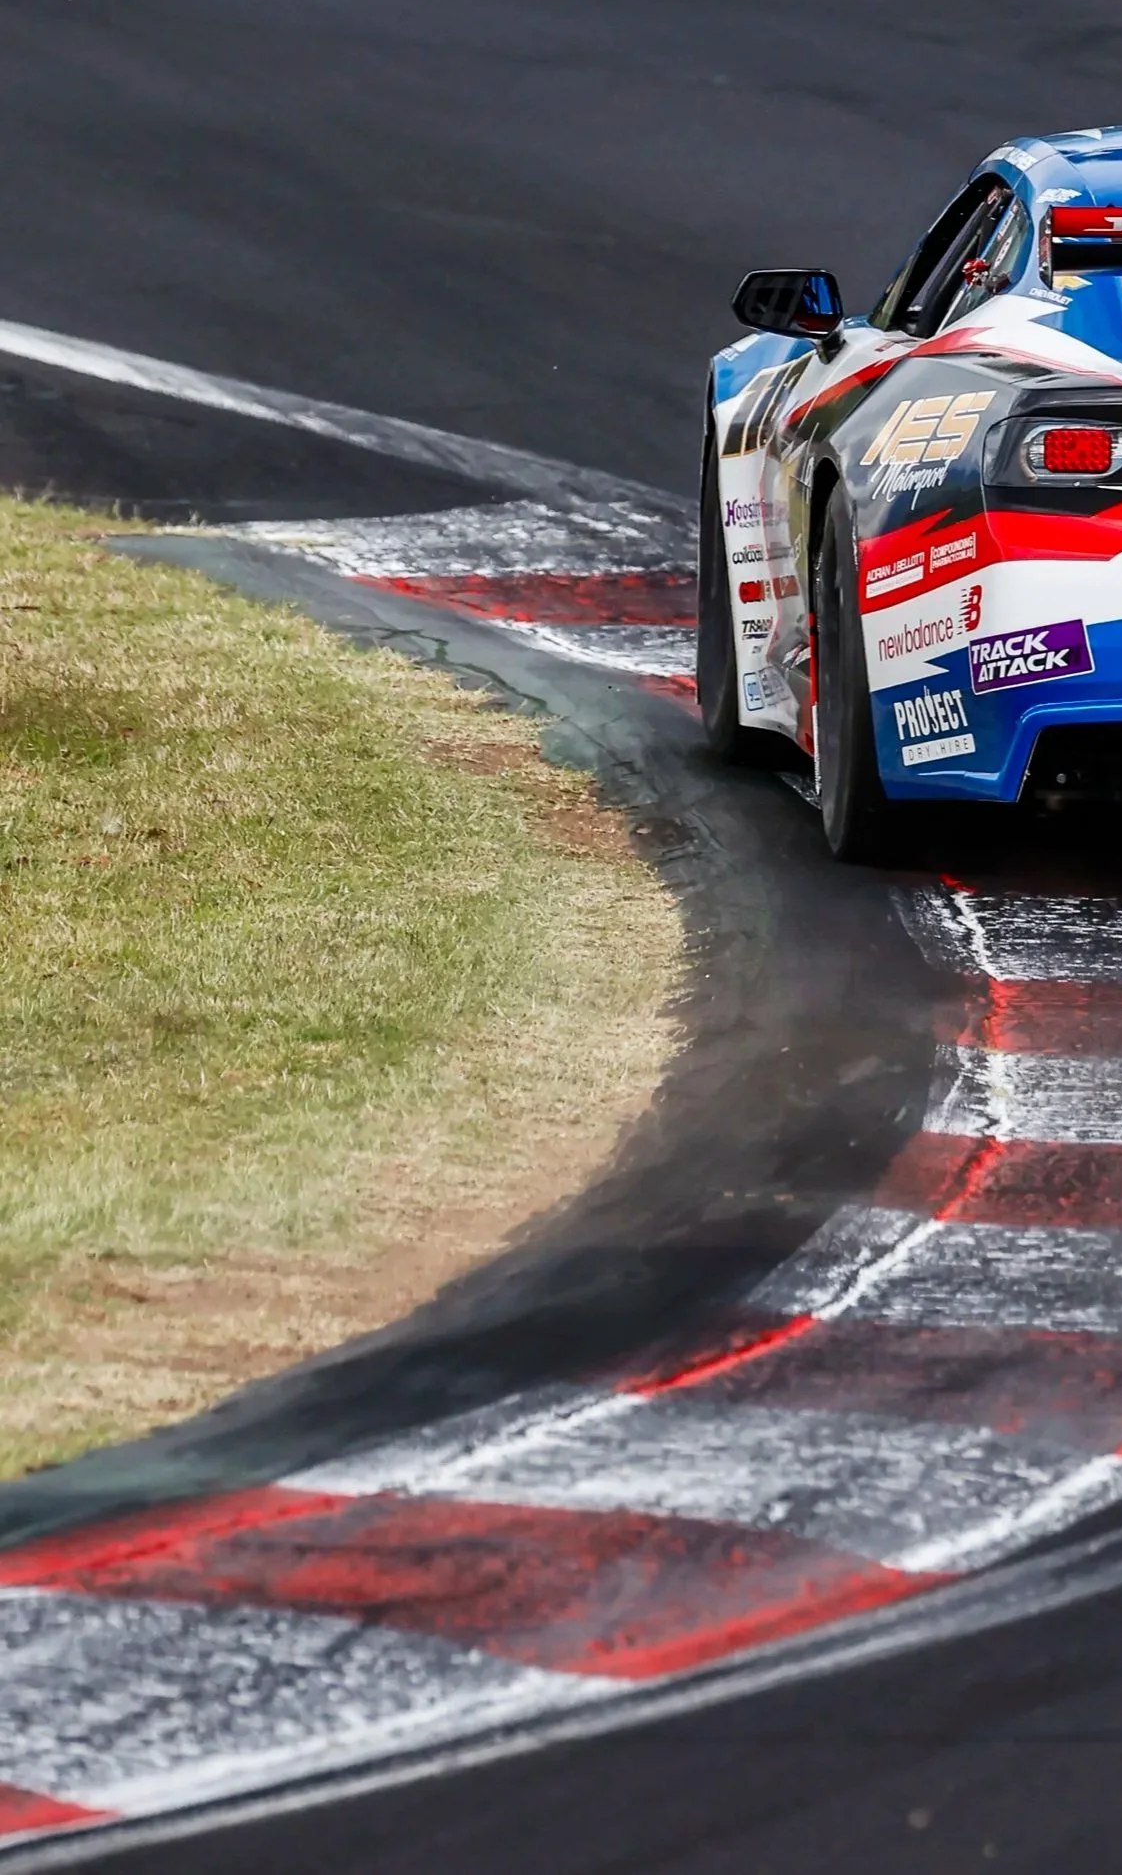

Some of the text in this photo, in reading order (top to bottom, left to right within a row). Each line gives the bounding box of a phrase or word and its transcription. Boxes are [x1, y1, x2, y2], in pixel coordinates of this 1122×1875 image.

[866, 564, 892, 583] ADRIAN
[971, 630, 1050, 665] TRACK
[977, 648, 1070, 683] ATTACK
